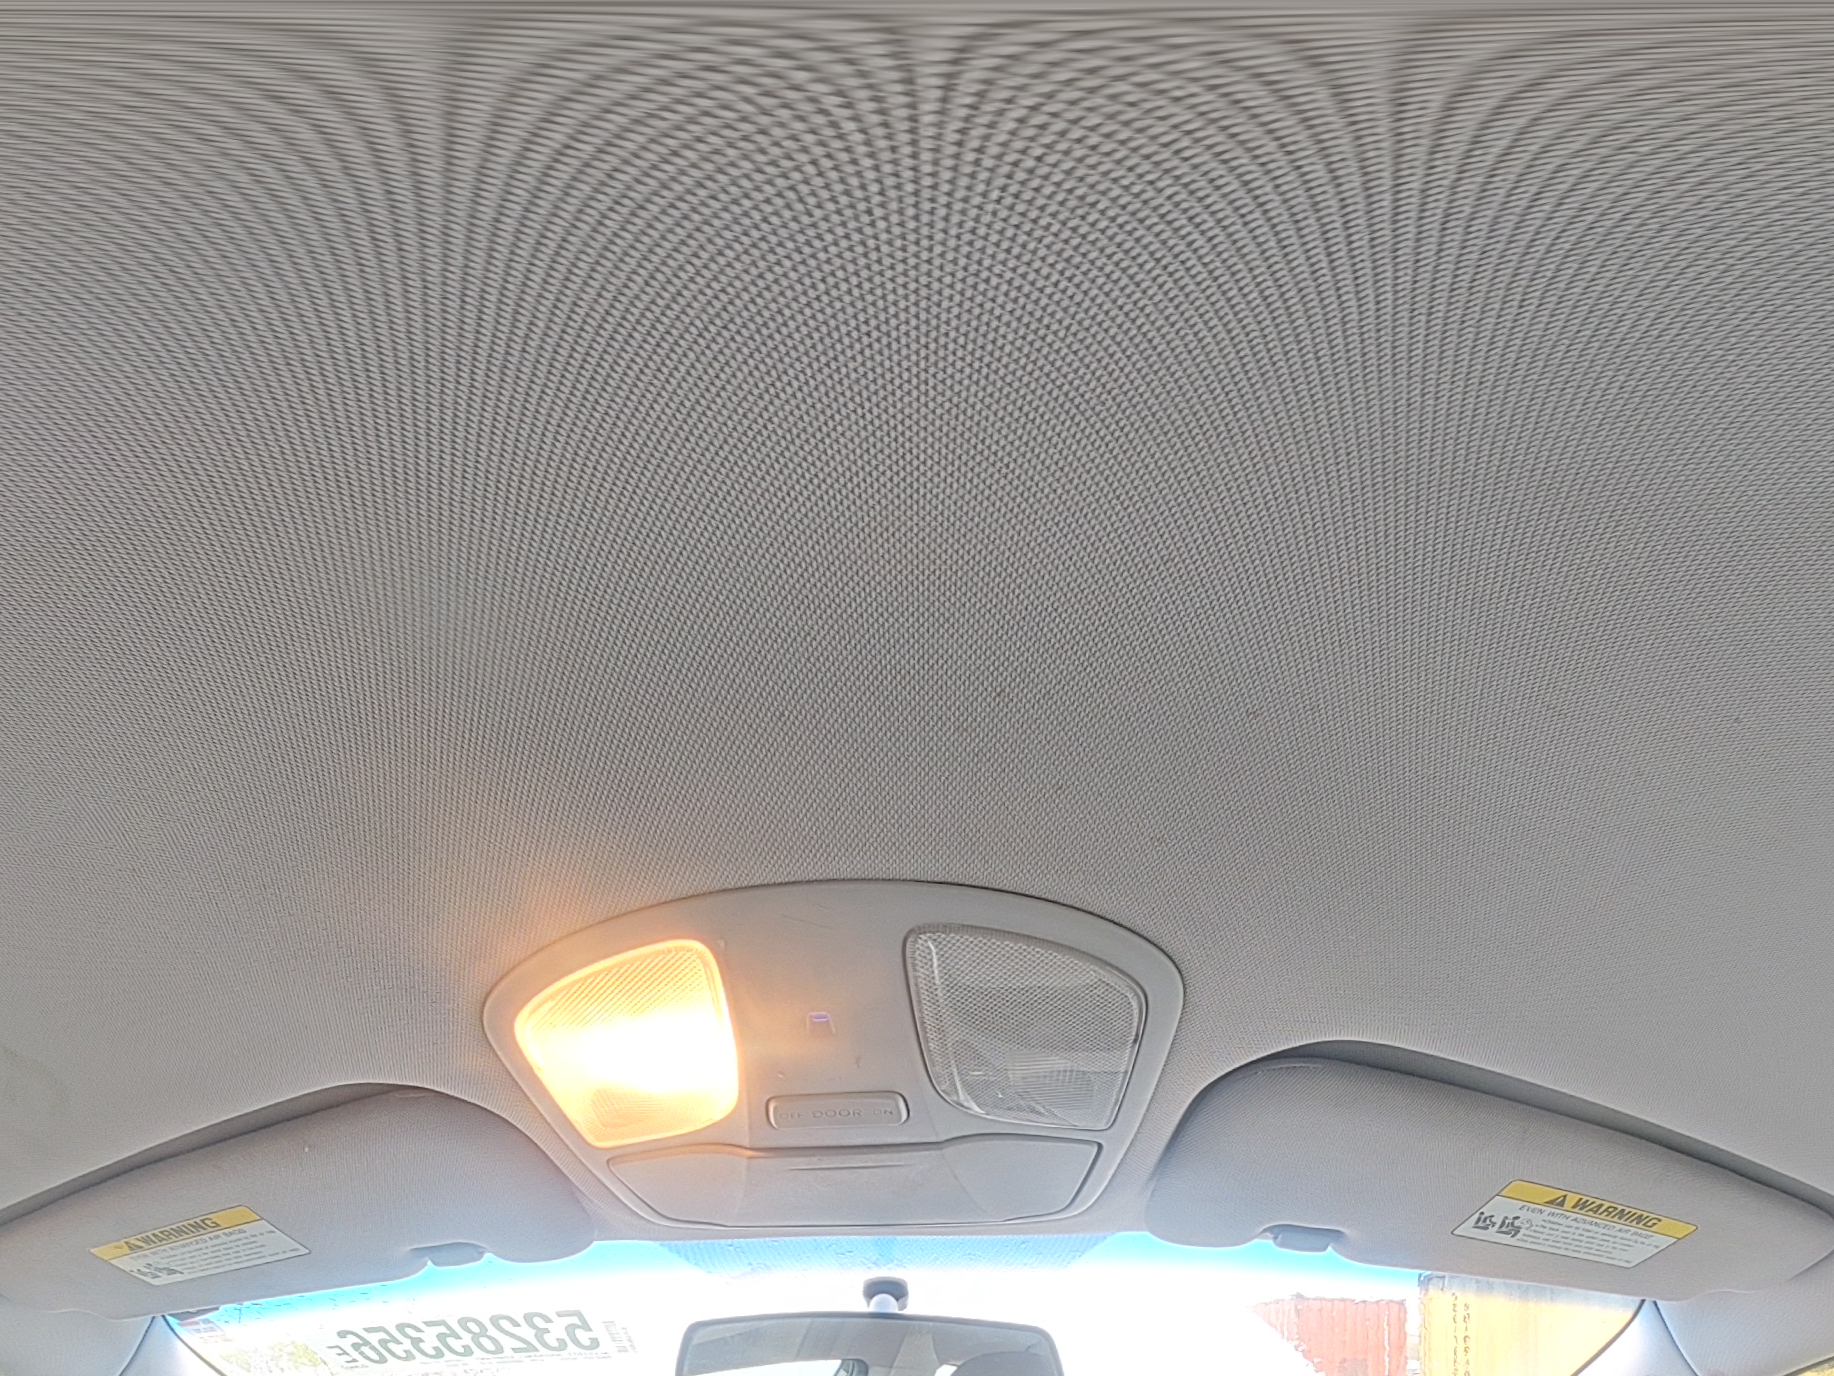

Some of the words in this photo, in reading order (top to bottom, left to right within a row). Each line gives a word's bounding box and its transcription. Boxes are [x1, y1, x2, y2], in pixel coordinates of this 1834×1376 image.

[810, 1108, 863, 1119] DOOR
[1518, 1204, 1546, 1215] EVEN
[1570, 1197, 1663, 1229] WARNING
[135, 1217, 221, 1248] WARNING
